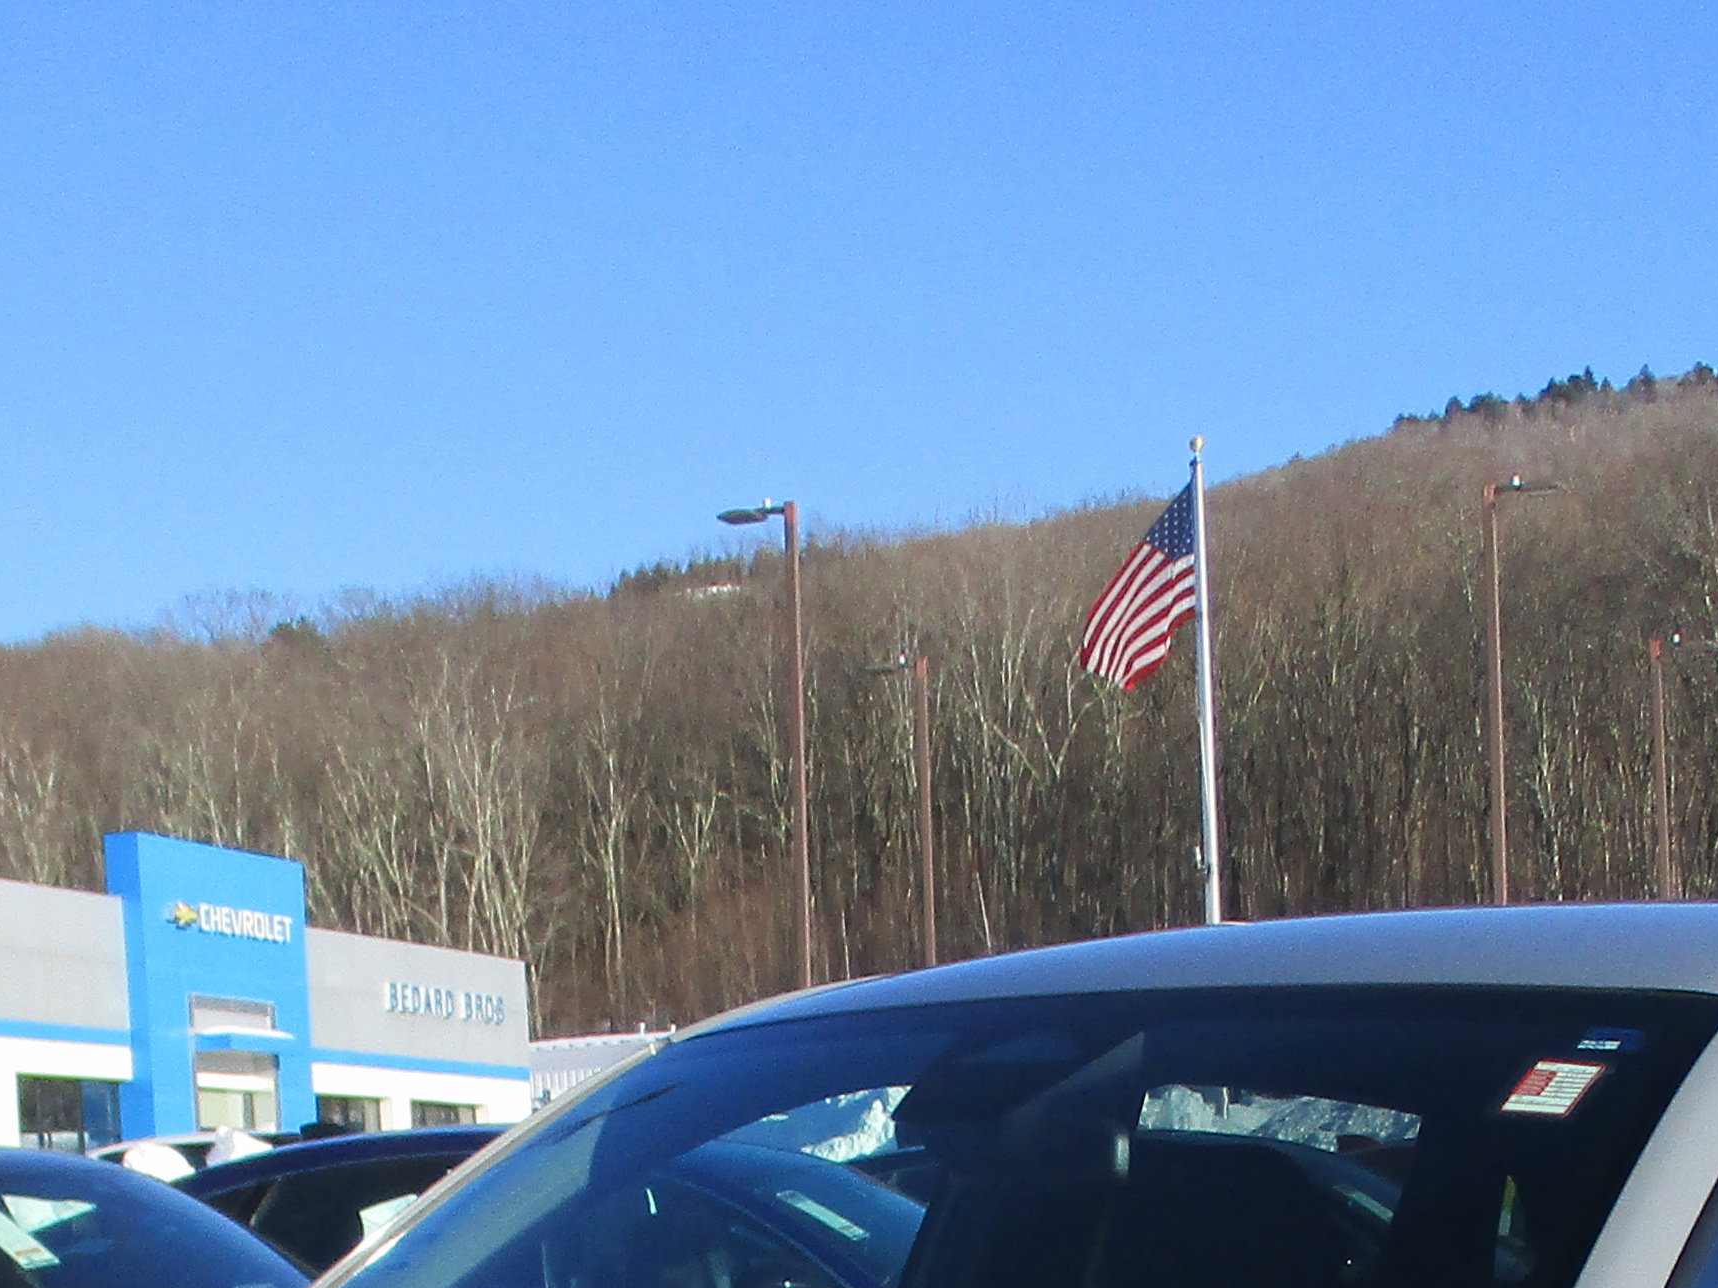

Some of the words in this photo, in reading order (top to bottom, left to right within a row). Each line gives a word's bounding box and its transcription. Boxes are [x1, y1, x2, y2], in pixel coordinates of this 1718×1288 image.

[199, 902, 292, 942] CHEVROLET
[385, 980, 455, 1019] BEDARD
[460, 990, 505, 1024] BROS
